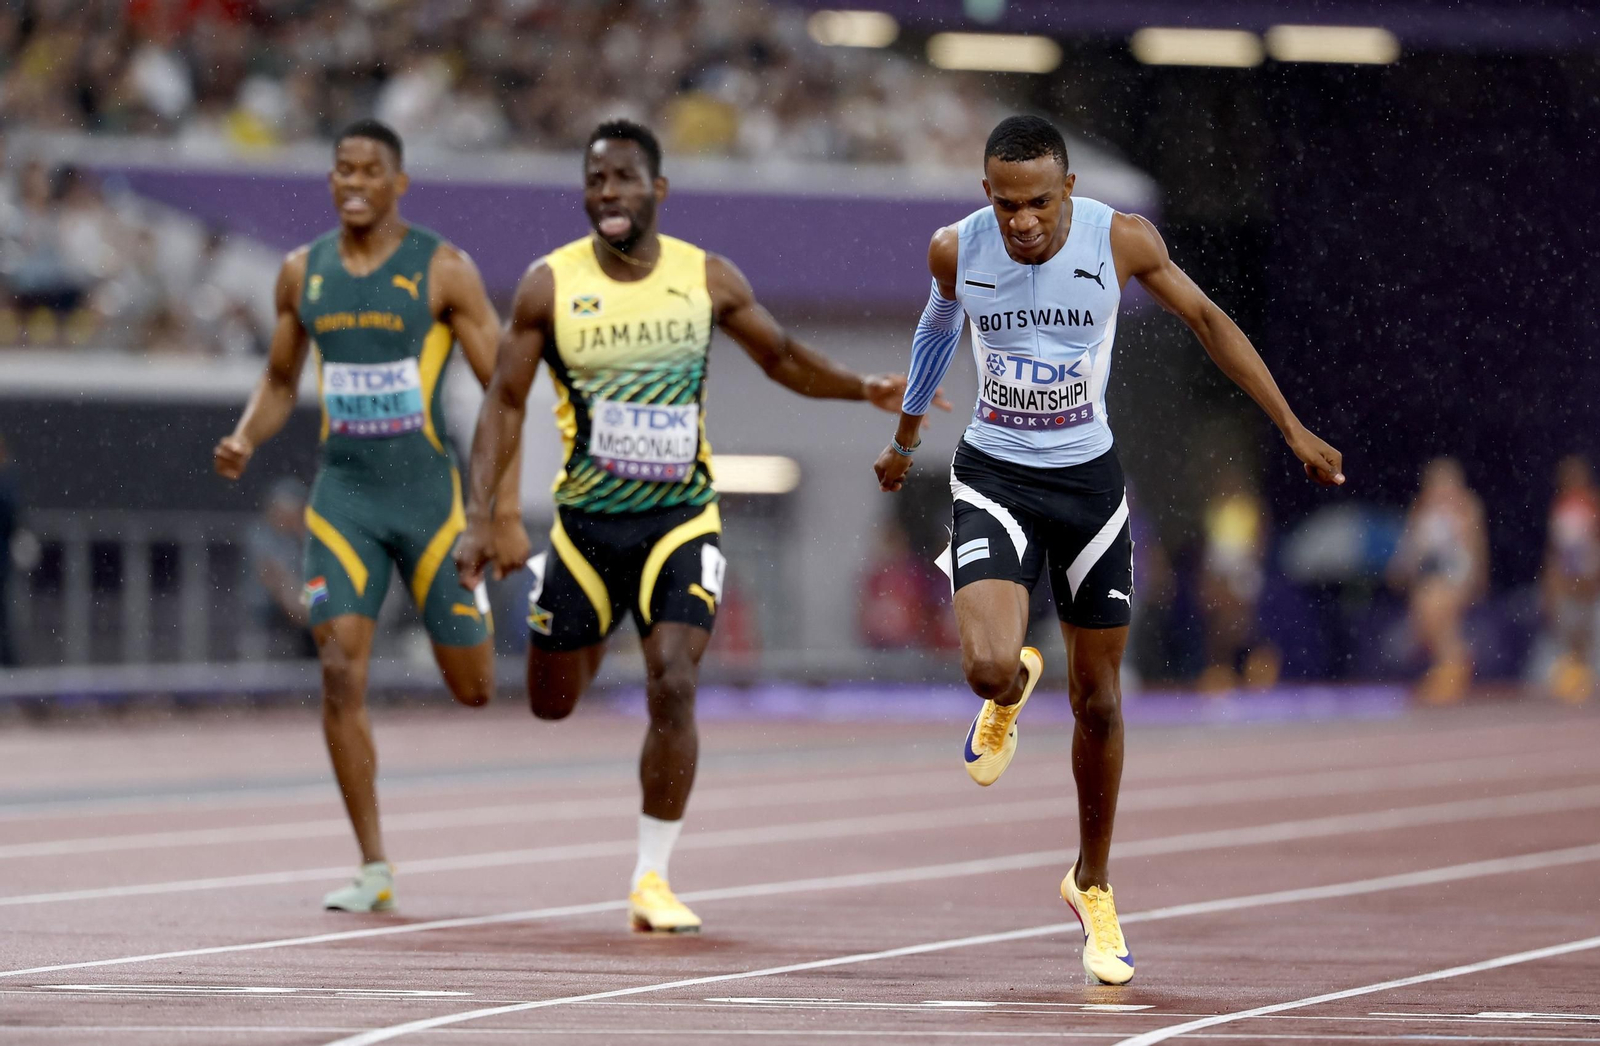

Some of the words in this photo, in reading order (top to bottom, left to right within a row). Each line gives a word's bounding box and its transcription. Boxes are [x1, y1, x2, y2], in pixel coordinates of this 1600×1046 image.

[980, 308, 1094, 332] BOTSWANA
[575, 319, 698, 353] JAMAICA
[348, 368, 408, 390] TDK
[1007, 355, 1083, 385] TDK
[335, 392, 408, 415] NENE
[983, 375, 1087, 411] KEBINATSHIPI
[626, 407, 690, 430] TDK
[598, 432, 691, 458] McDONALD
